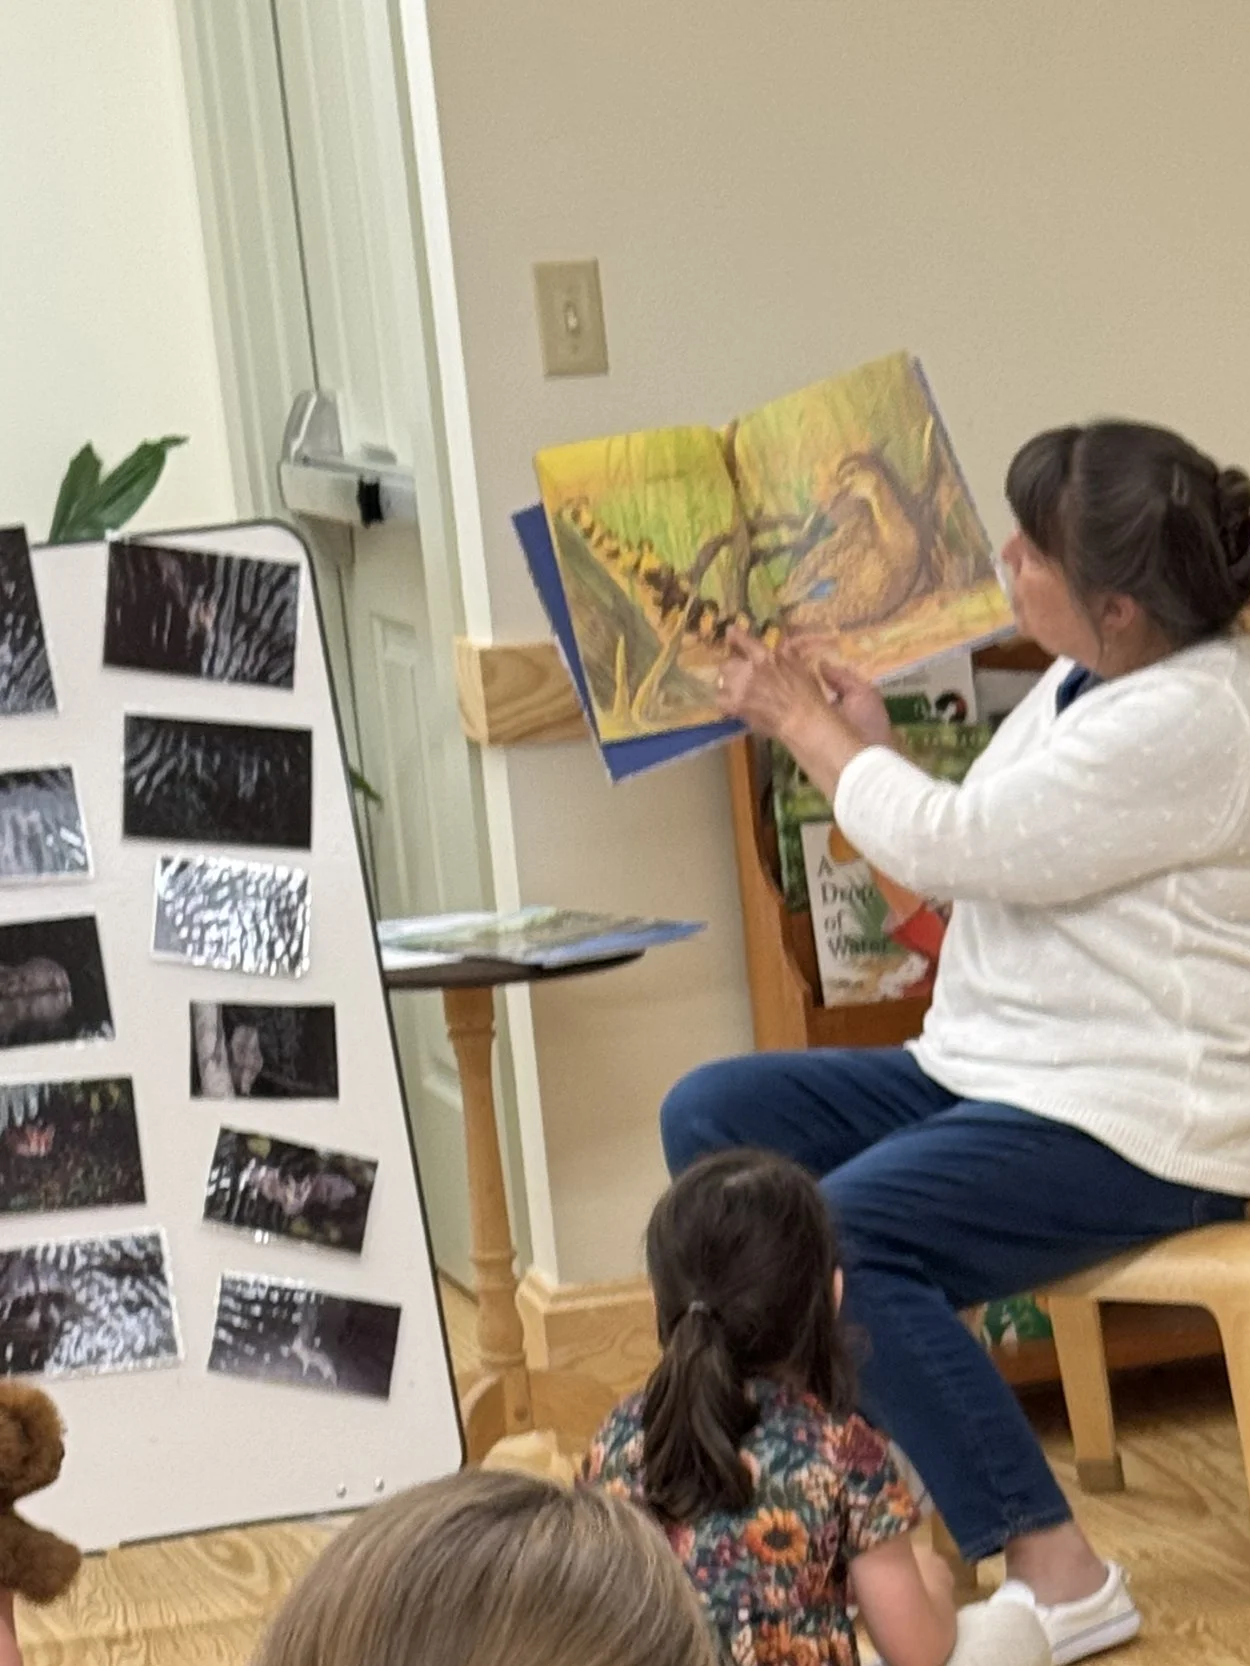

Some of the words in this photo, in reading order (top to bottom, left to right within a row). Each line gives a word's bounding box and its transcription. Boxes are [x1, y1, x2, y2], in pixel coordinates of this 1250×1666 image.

[817, 855, 834, 878] A
[821, 880, 876, 907] Drop
[823, 908, 843, 933] of
